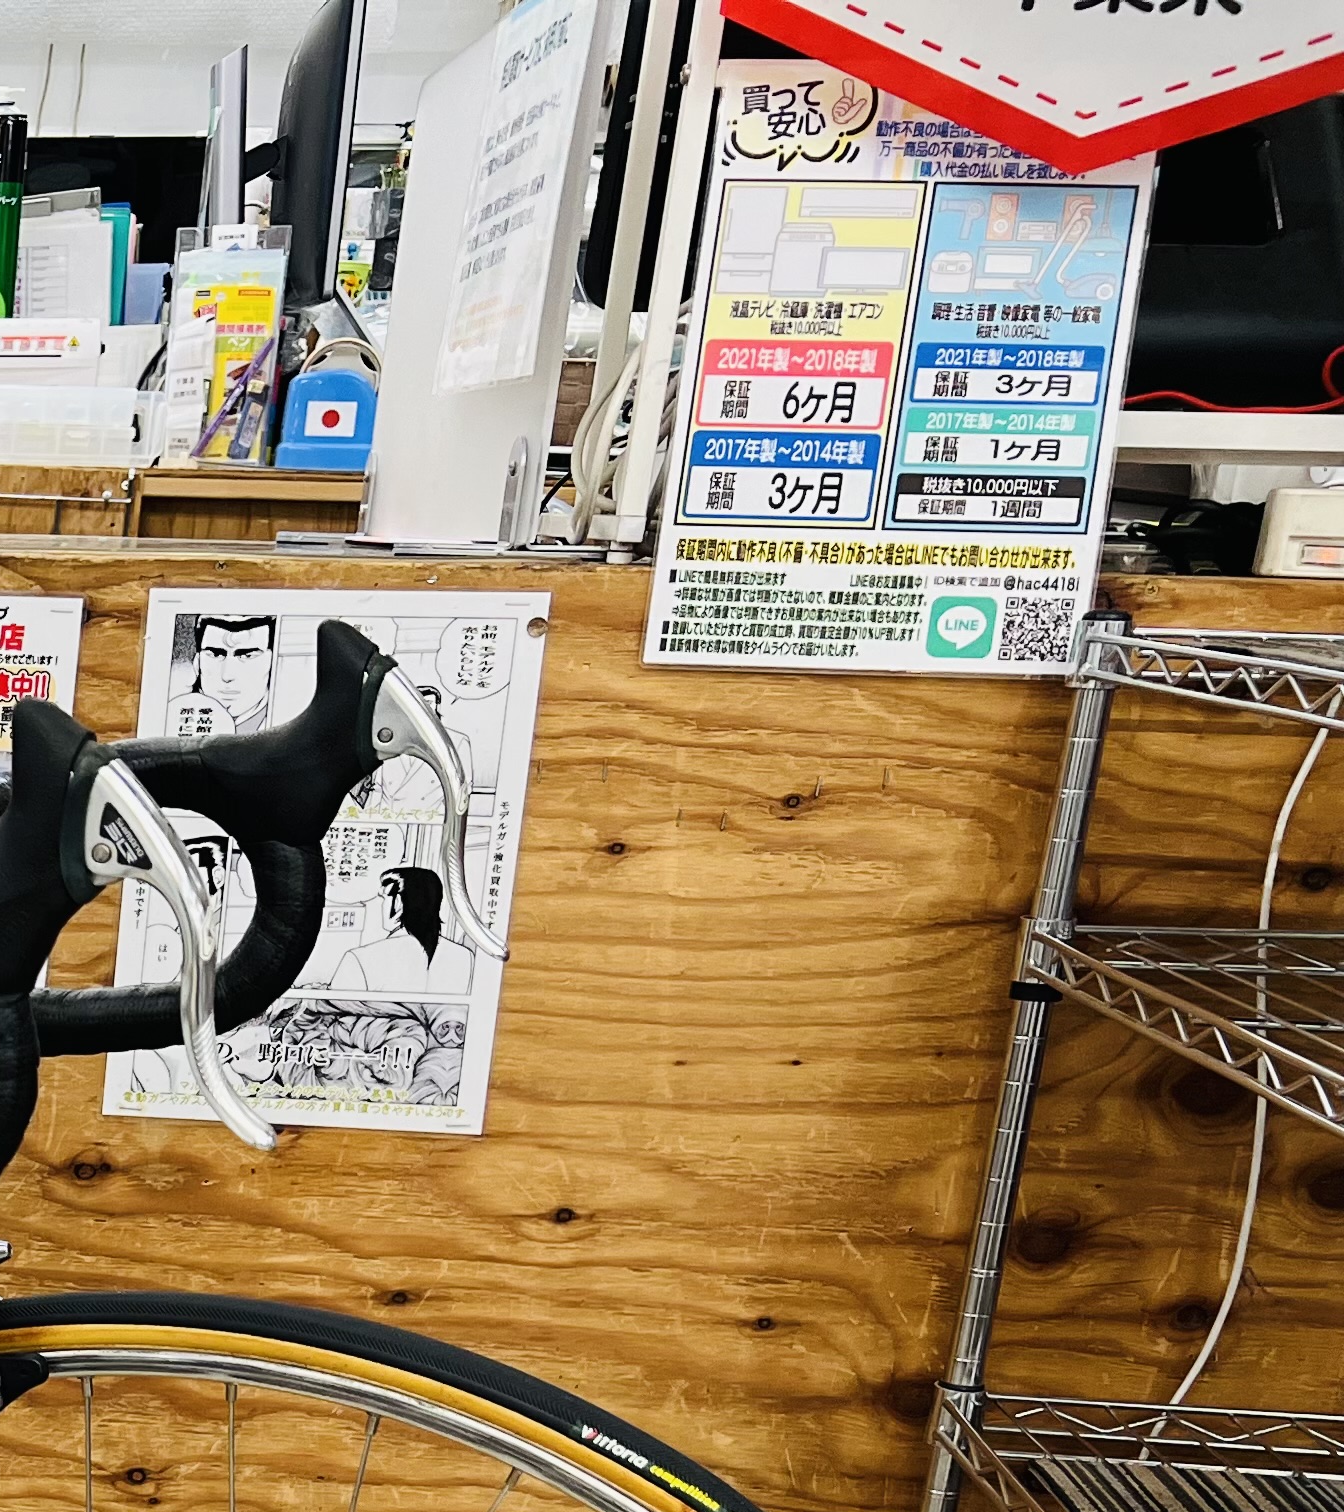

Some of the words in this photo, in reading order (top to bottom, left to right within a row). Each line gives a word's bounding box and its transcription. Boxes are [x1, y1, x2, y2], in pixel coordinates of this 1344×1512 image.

[742, 80, 825, 115] 買って
[767, 108, 826, 140] 安心
[935, 371, 969, 384] 保証
[724, 381, 752, 399] 保証
[932, 383, 968, 398] 期間
[720, 400, 749, 419] 期間
[925, 436, 959, 449] 保証
[923, 449, 958, 463] 期間
[709, 472, 737, 490] 保証
[705, 491, 734, 510] 期間
[918, 499, 966, 515] 保証期間
[992, 500, 1043, 518] 1週間
[944, 619, 979, 631] LINE
[581, 1424, 650, 1469] Vittoria
[650, 1465, 721, 1512] competition
